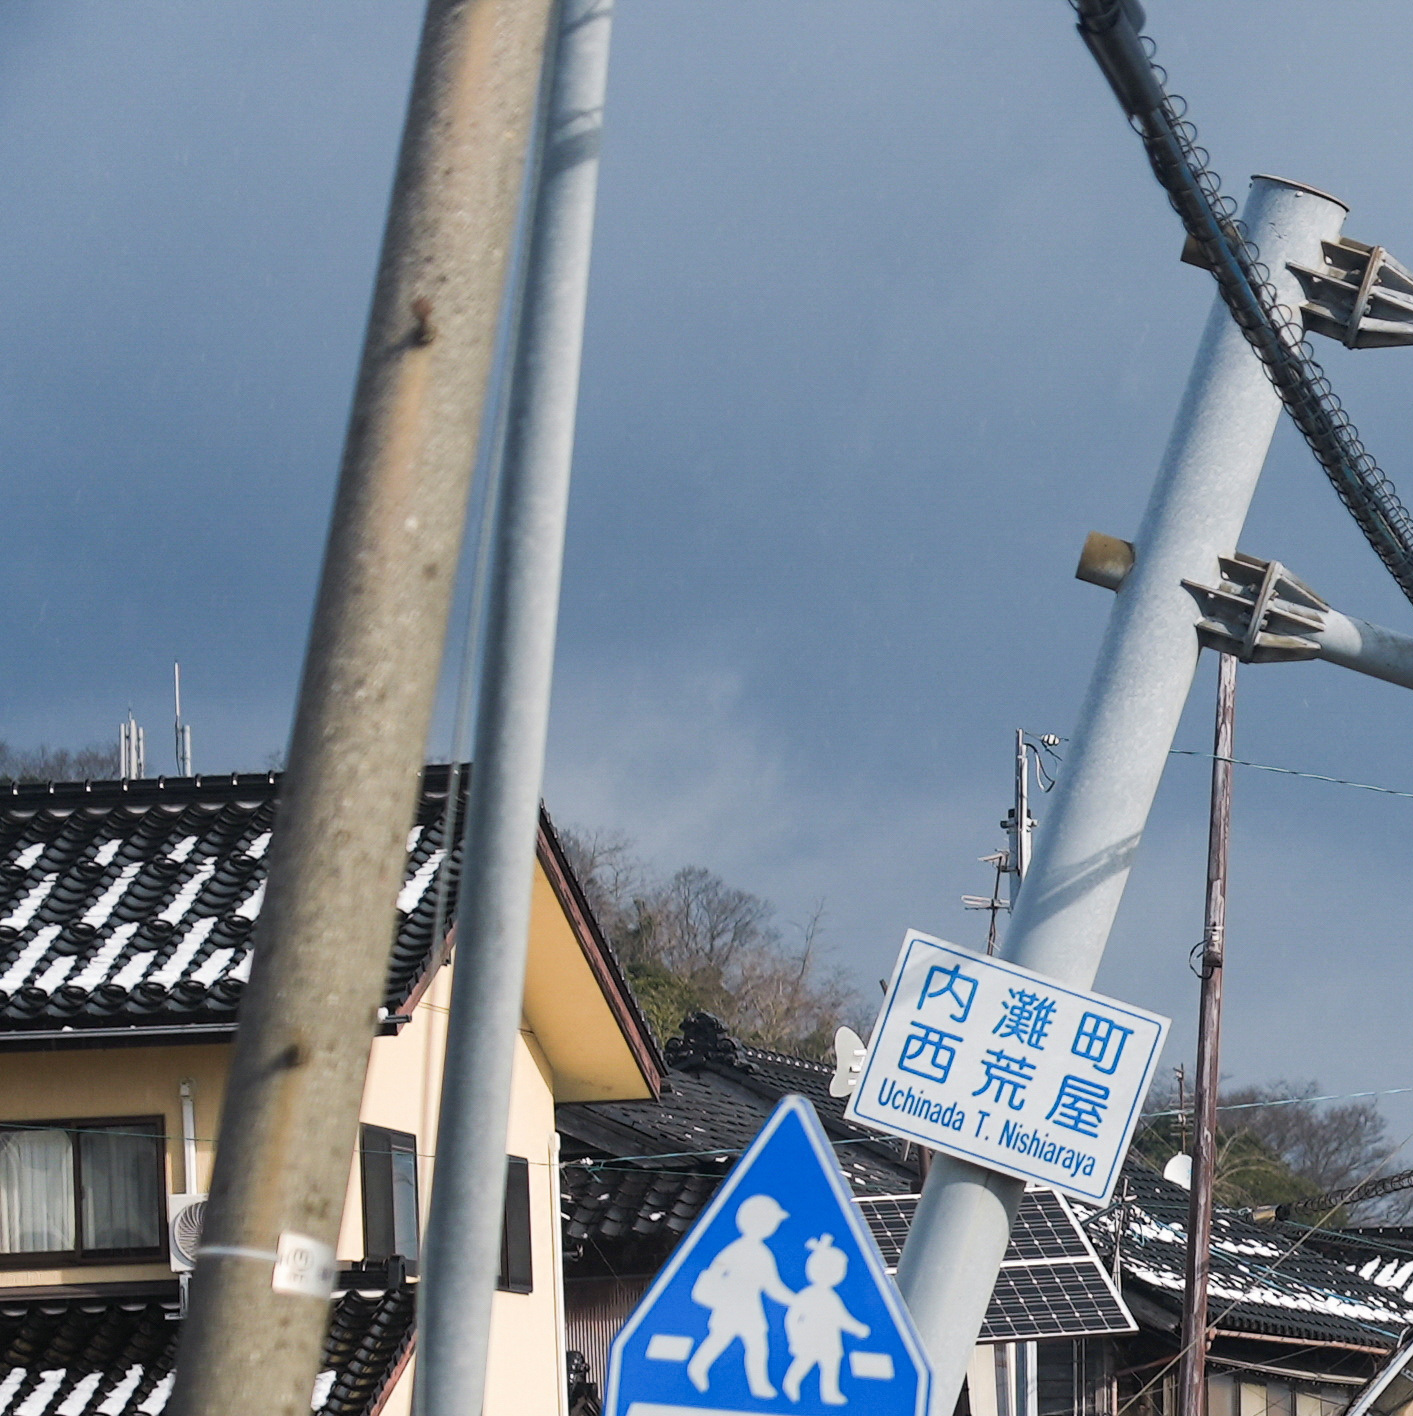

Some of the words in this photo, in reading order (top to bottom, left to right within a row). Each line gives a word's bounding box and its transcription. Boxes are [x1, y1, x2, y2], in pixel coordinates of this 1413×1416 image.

[917, 963, 1134, 1076] 内灘町
[877, 1078, 967, 1132] Uchinada
[974, 1110, 991, 1141] T.
[998, 1120, 1096, 1178] Nishiaraya
[898, 1020, 1111, 1139] 西荒屋
